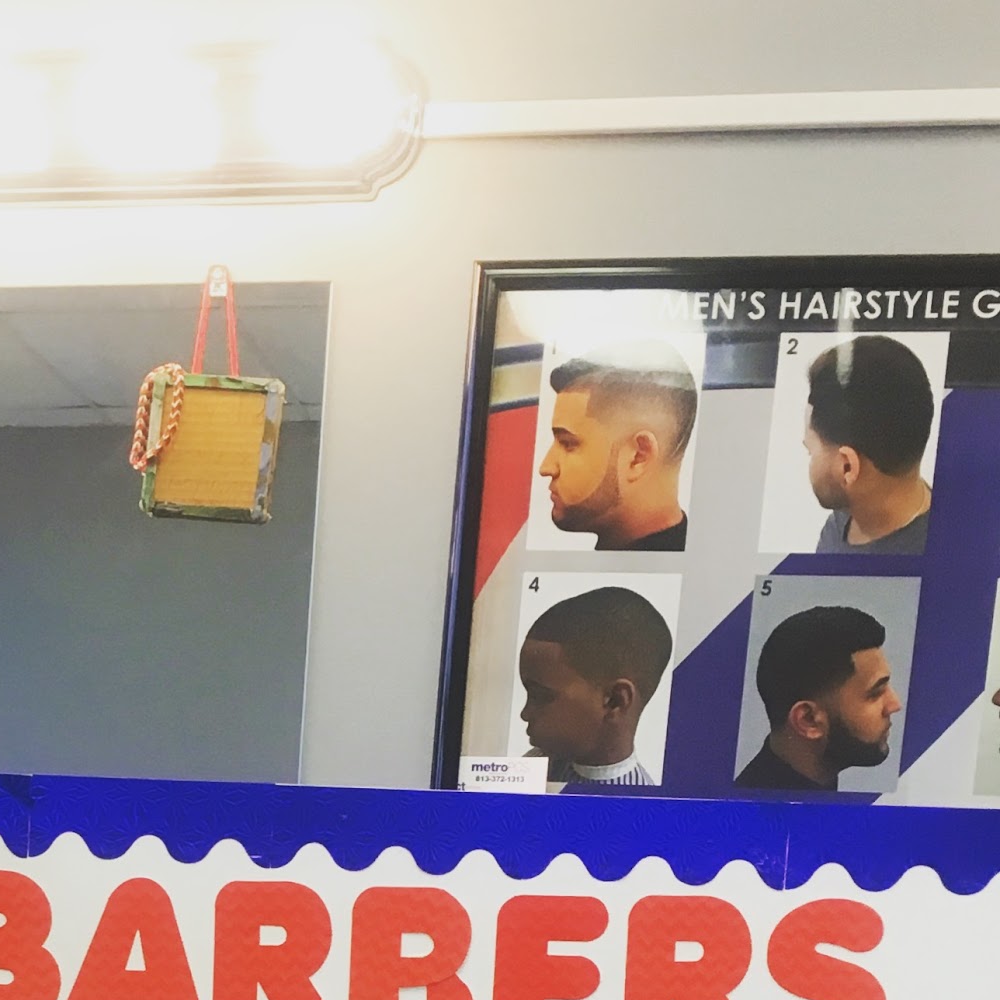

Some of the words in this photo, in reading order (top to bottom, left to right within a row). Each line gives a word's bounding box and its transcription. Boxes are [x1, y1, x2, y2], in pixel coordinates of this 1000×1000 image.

[657, 290, 766, 321] MEN'S
[779, 289, 961, 320] HAIRSTYLE
[786, 338, 799, 355] 2
[529, 577, 540, 593] 4
[760, 580, 773, 597] 5
